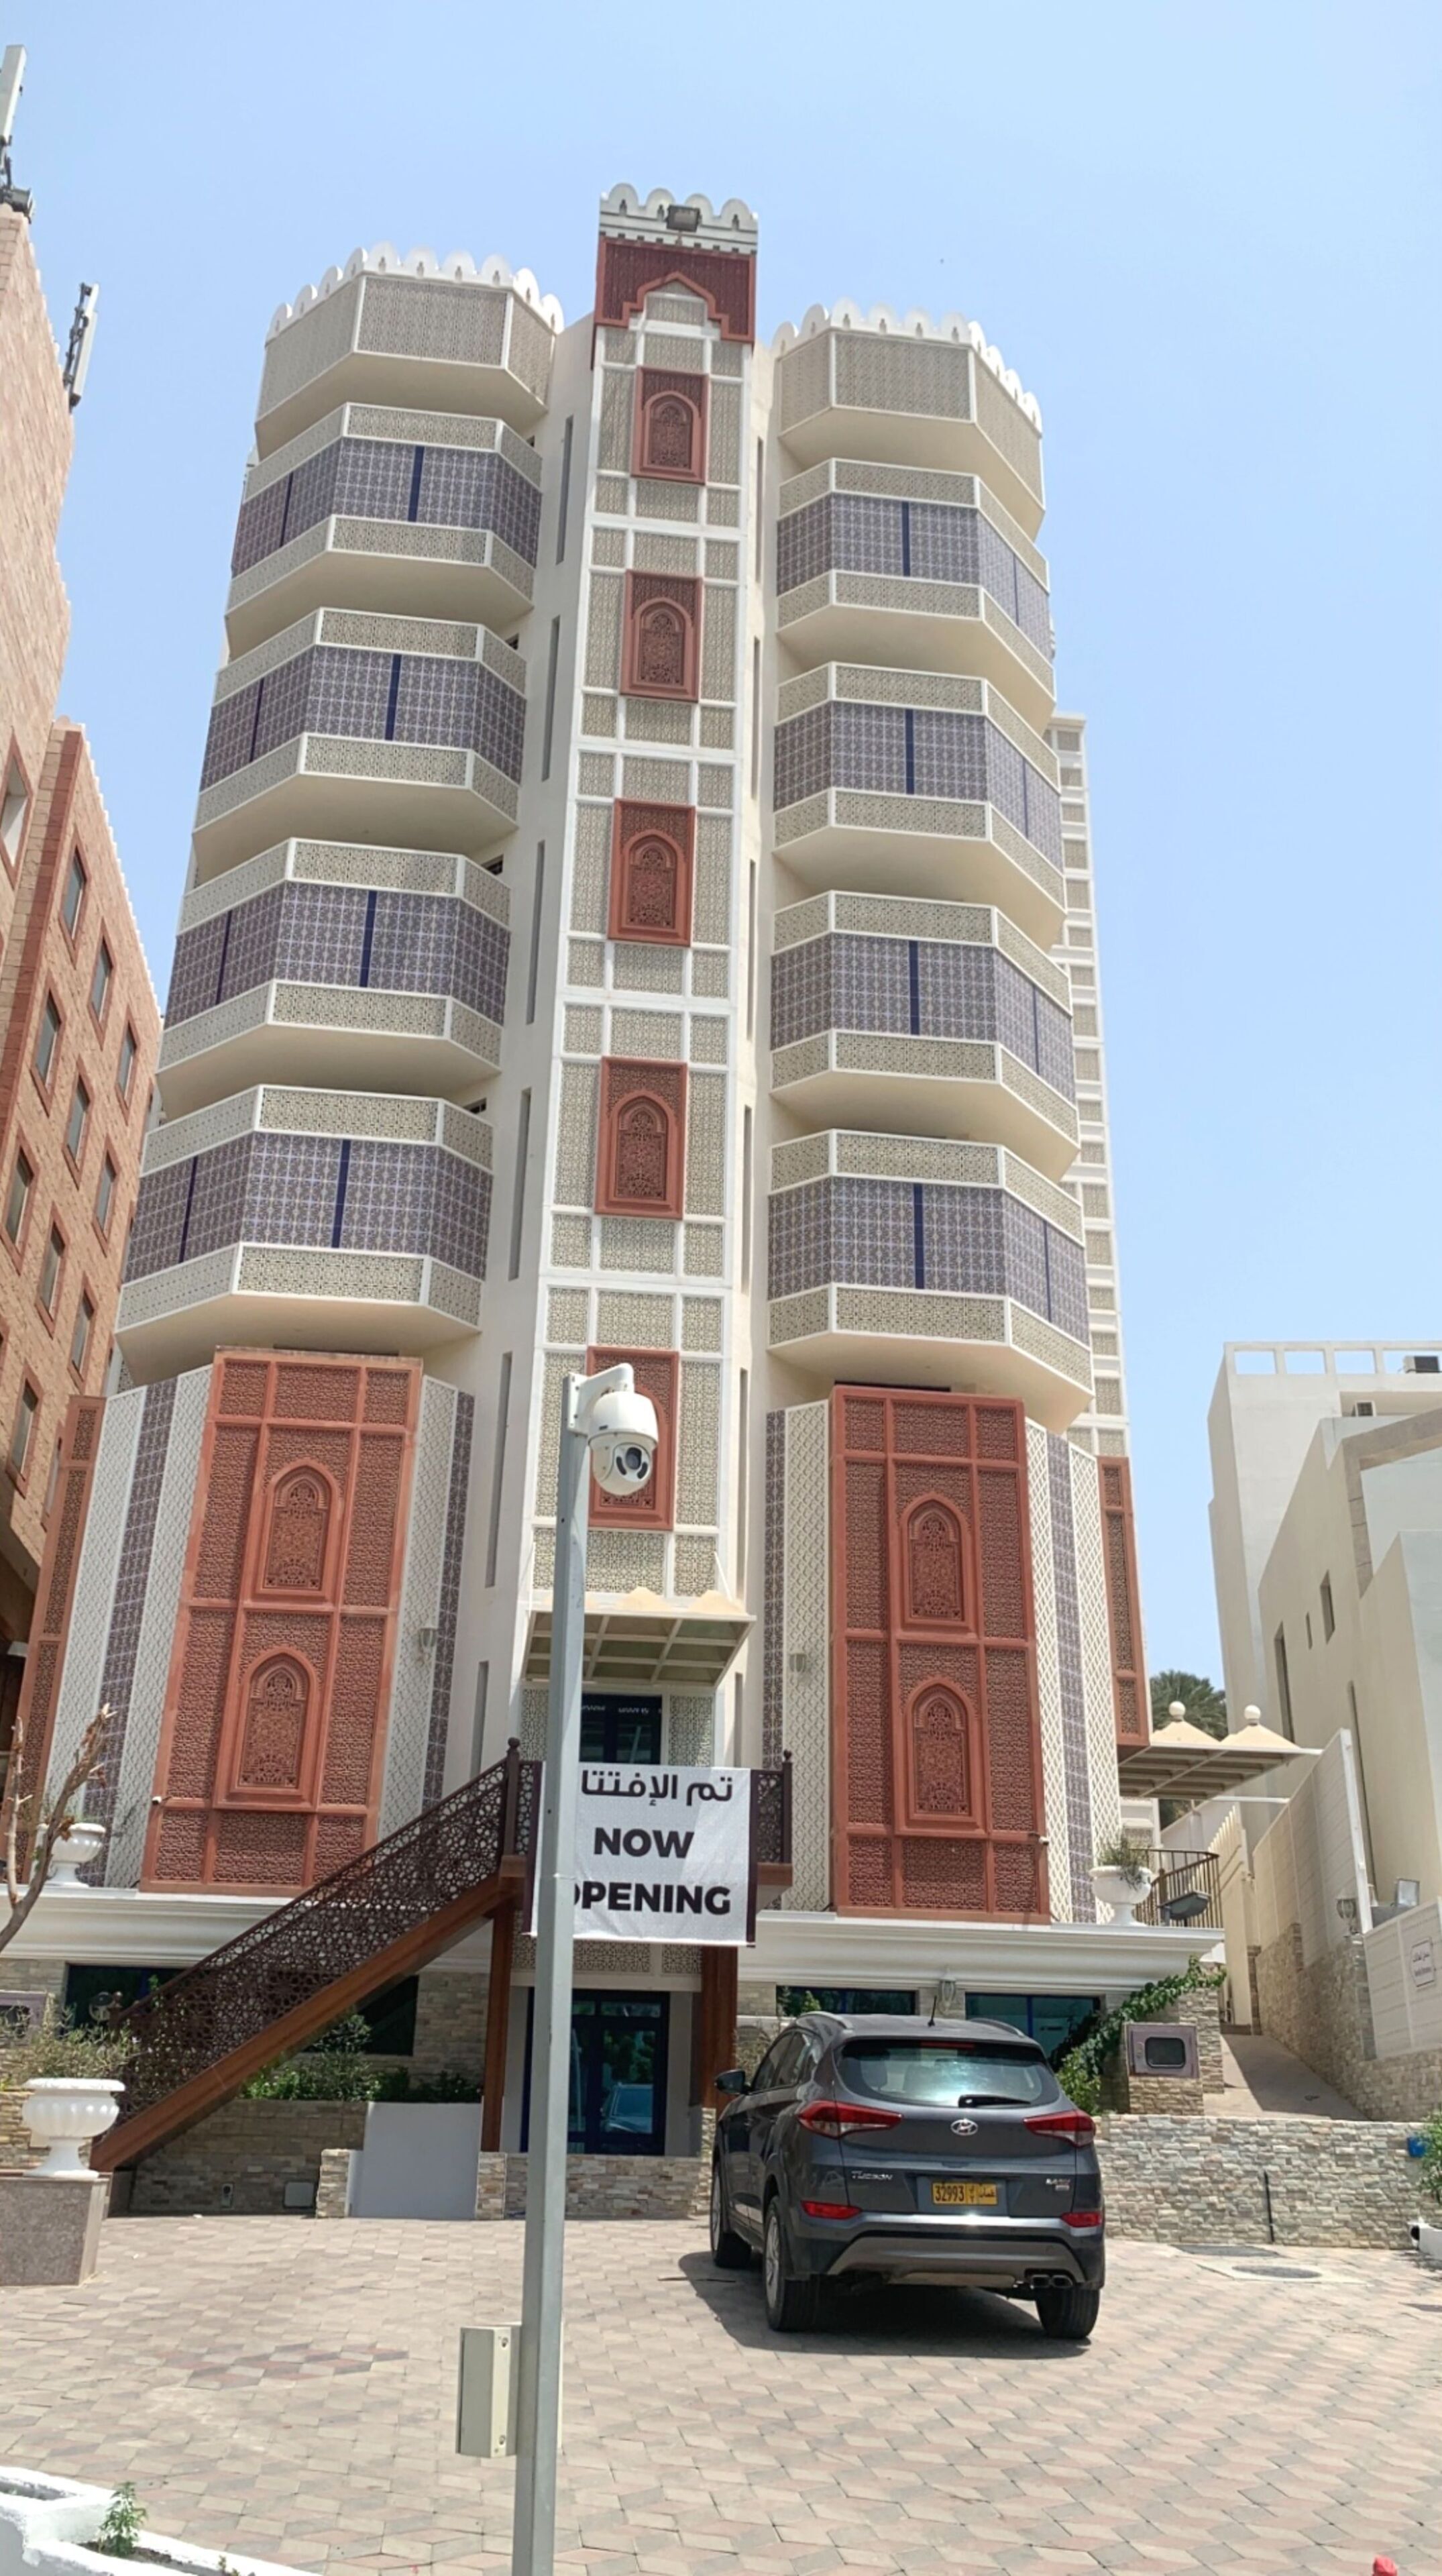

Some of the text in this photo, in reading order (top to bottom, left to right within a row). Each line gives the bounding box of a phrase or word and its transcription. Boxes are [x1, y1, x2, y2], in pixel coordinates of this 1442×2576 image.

[581, 1770, 732, 1806] تم الإفتتا
[594, 1827, 695, 1859] NOW
[574, 1880, 731, 1915] PENING
[935, 2185, 964, 2202] 32993
